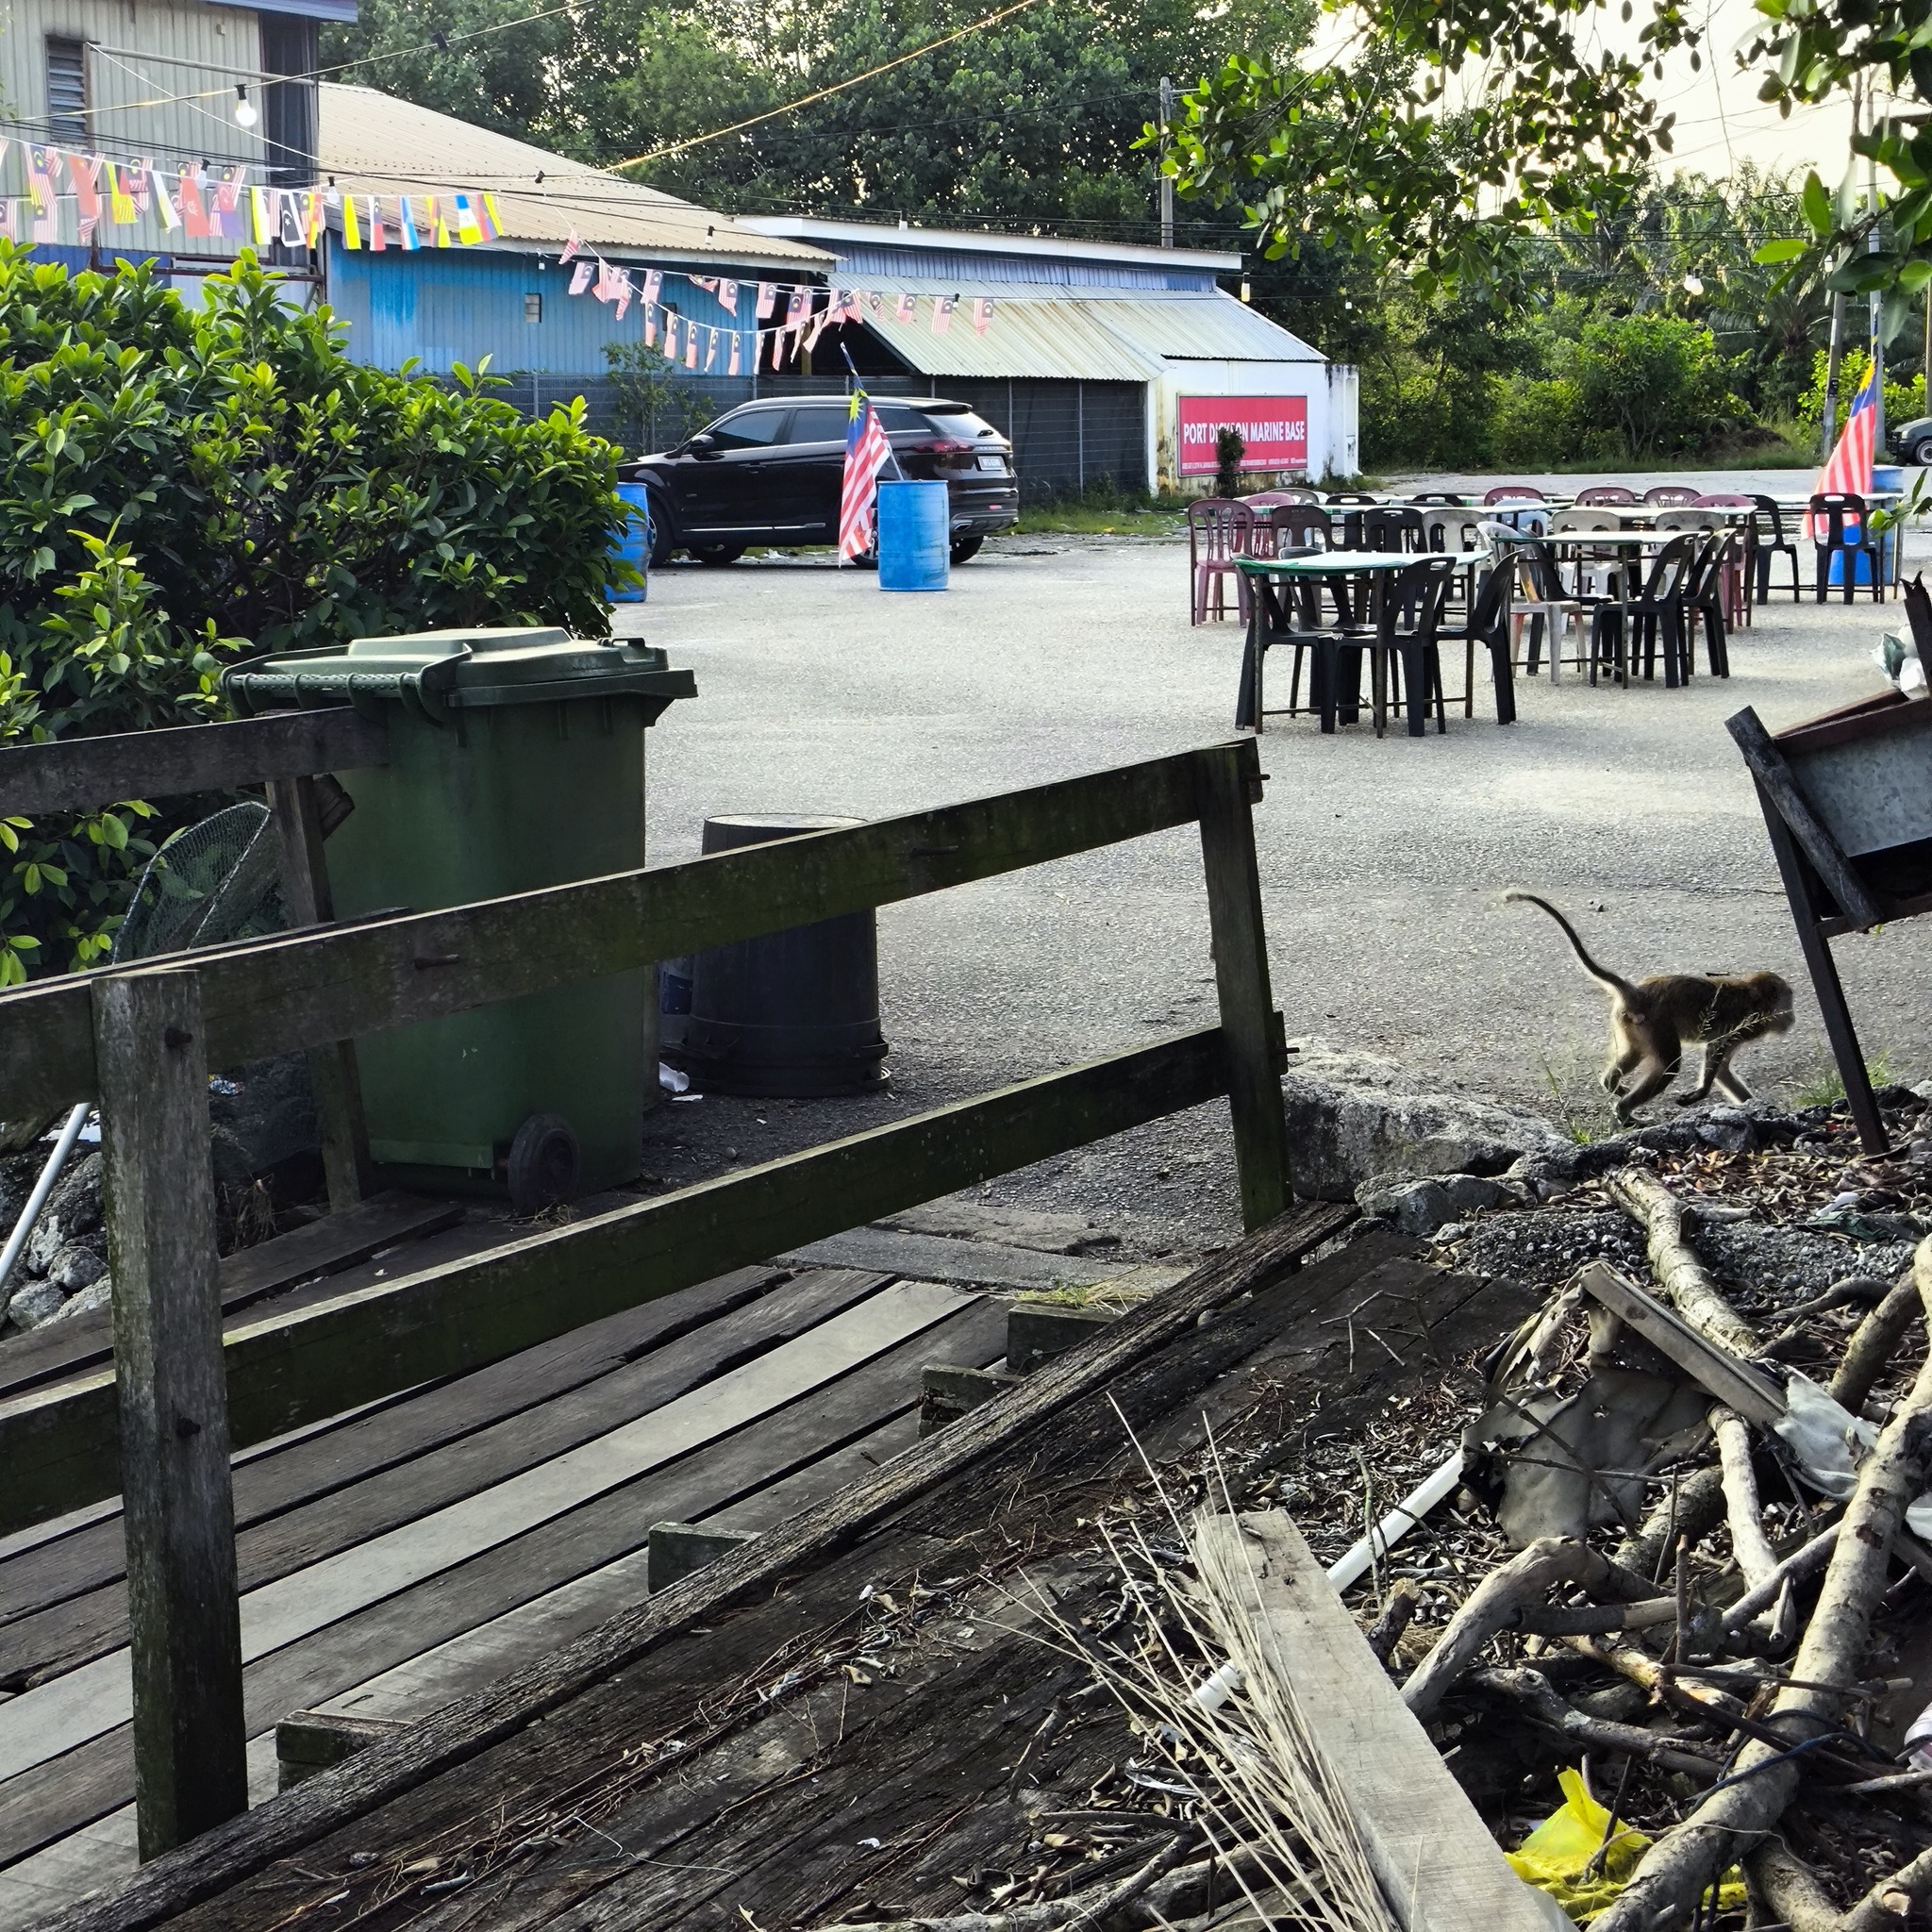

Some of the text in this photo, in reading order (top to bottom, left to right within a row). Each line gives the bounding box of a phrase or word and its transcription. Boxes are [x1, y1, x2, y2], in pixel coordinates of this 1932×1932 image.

[1183, 423, 1208, 444] PORT
[1250, 421, 1284, 442] MARINE
[1285, 420, 1305, 441] BASE
